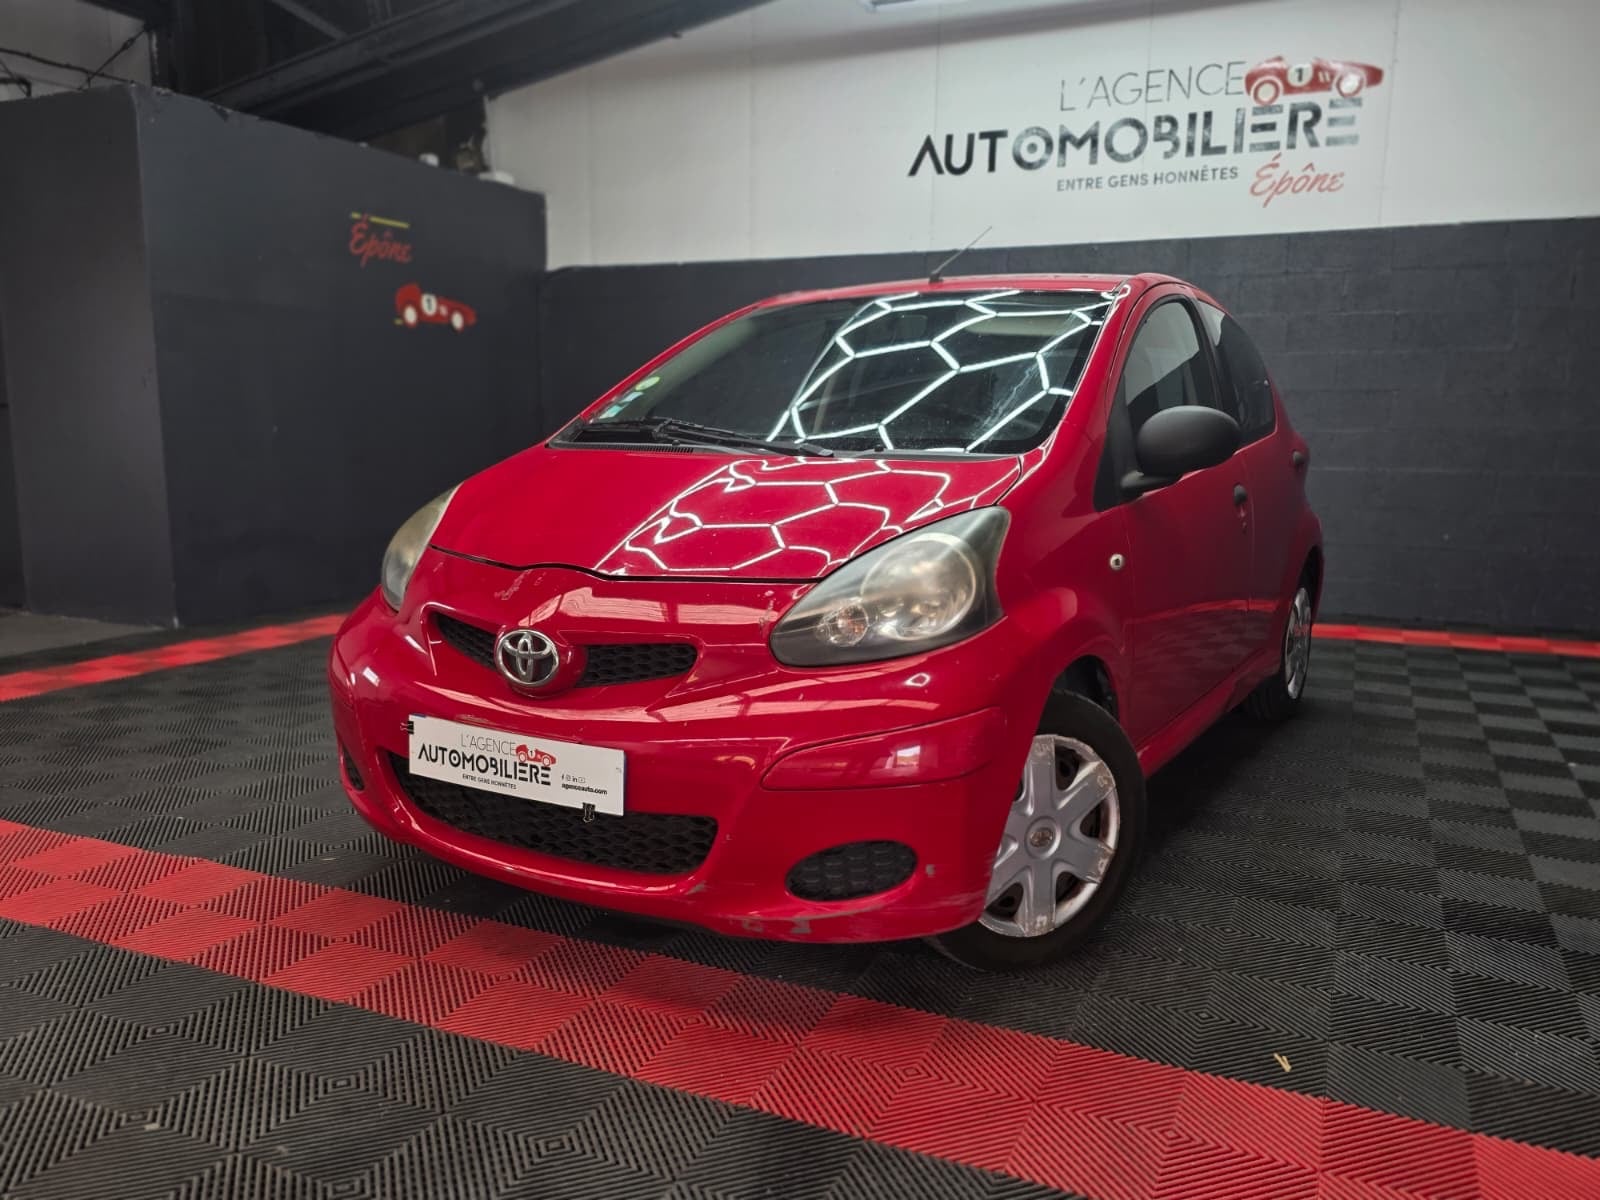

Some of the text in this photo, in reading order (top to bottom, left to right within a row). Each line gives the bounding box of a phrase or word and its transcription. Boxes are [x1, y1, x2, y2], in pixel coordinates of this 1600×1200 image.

[1060, 61, 1247, 111] L'AGENCE
[1293, 67, 1303, 81] 1
[1057, 166, 1239, 192] ENTRE GENS HONNÊTES
[1250, 152, 1345, 208] Épône
[461, 733, 516, 756] L'AGENCE
[462, 773, 477, 782] ENTRE
